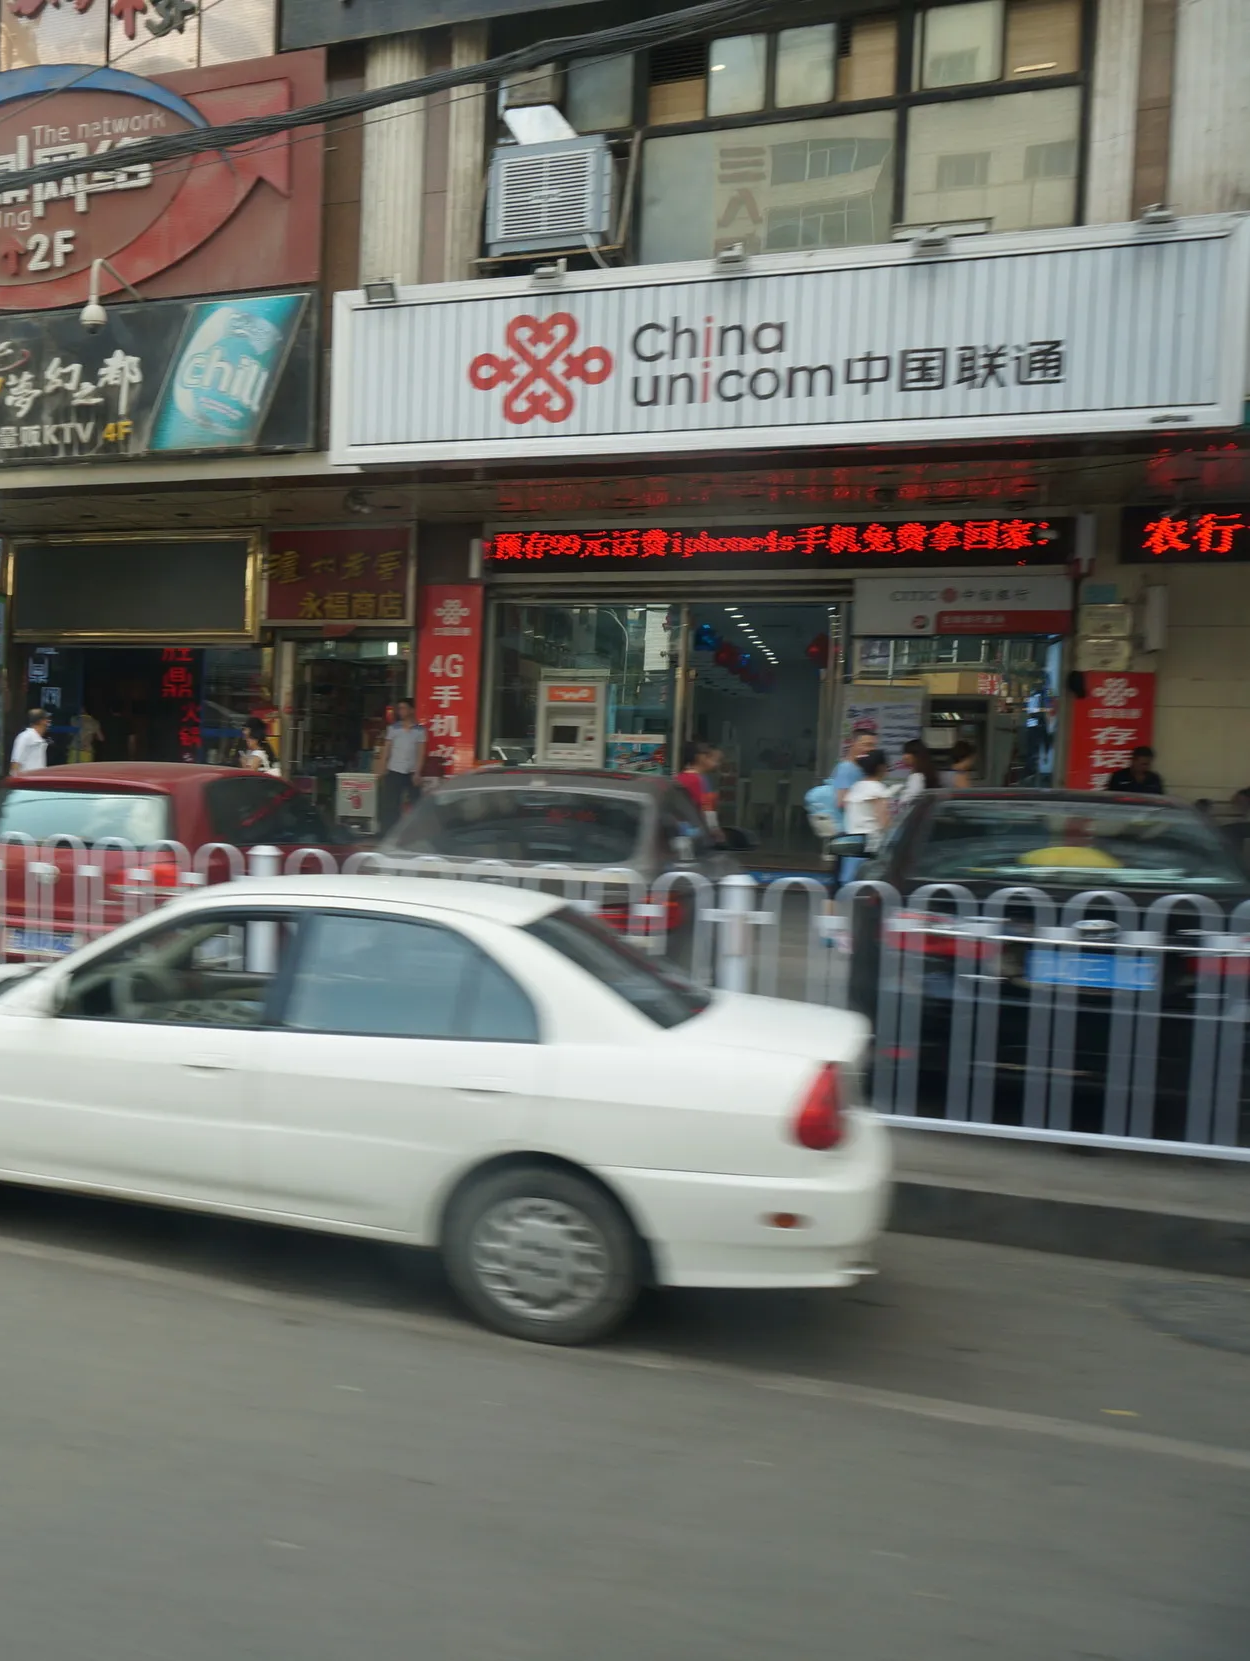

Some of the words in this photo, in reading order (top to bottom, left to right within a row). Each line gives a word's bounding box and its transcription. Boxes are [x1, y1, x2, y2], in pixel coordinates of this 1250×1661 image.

[32, 123, 71, 147] The
[77, 110, 167, 139] network
[26, 229, 76, 272] 2F
[632, 315, 787, 363] China
[632, 359, 835, 407] unicom
[843, 339, 1067, 396] 中国联通
[102, 420, 134, 442] 4F
